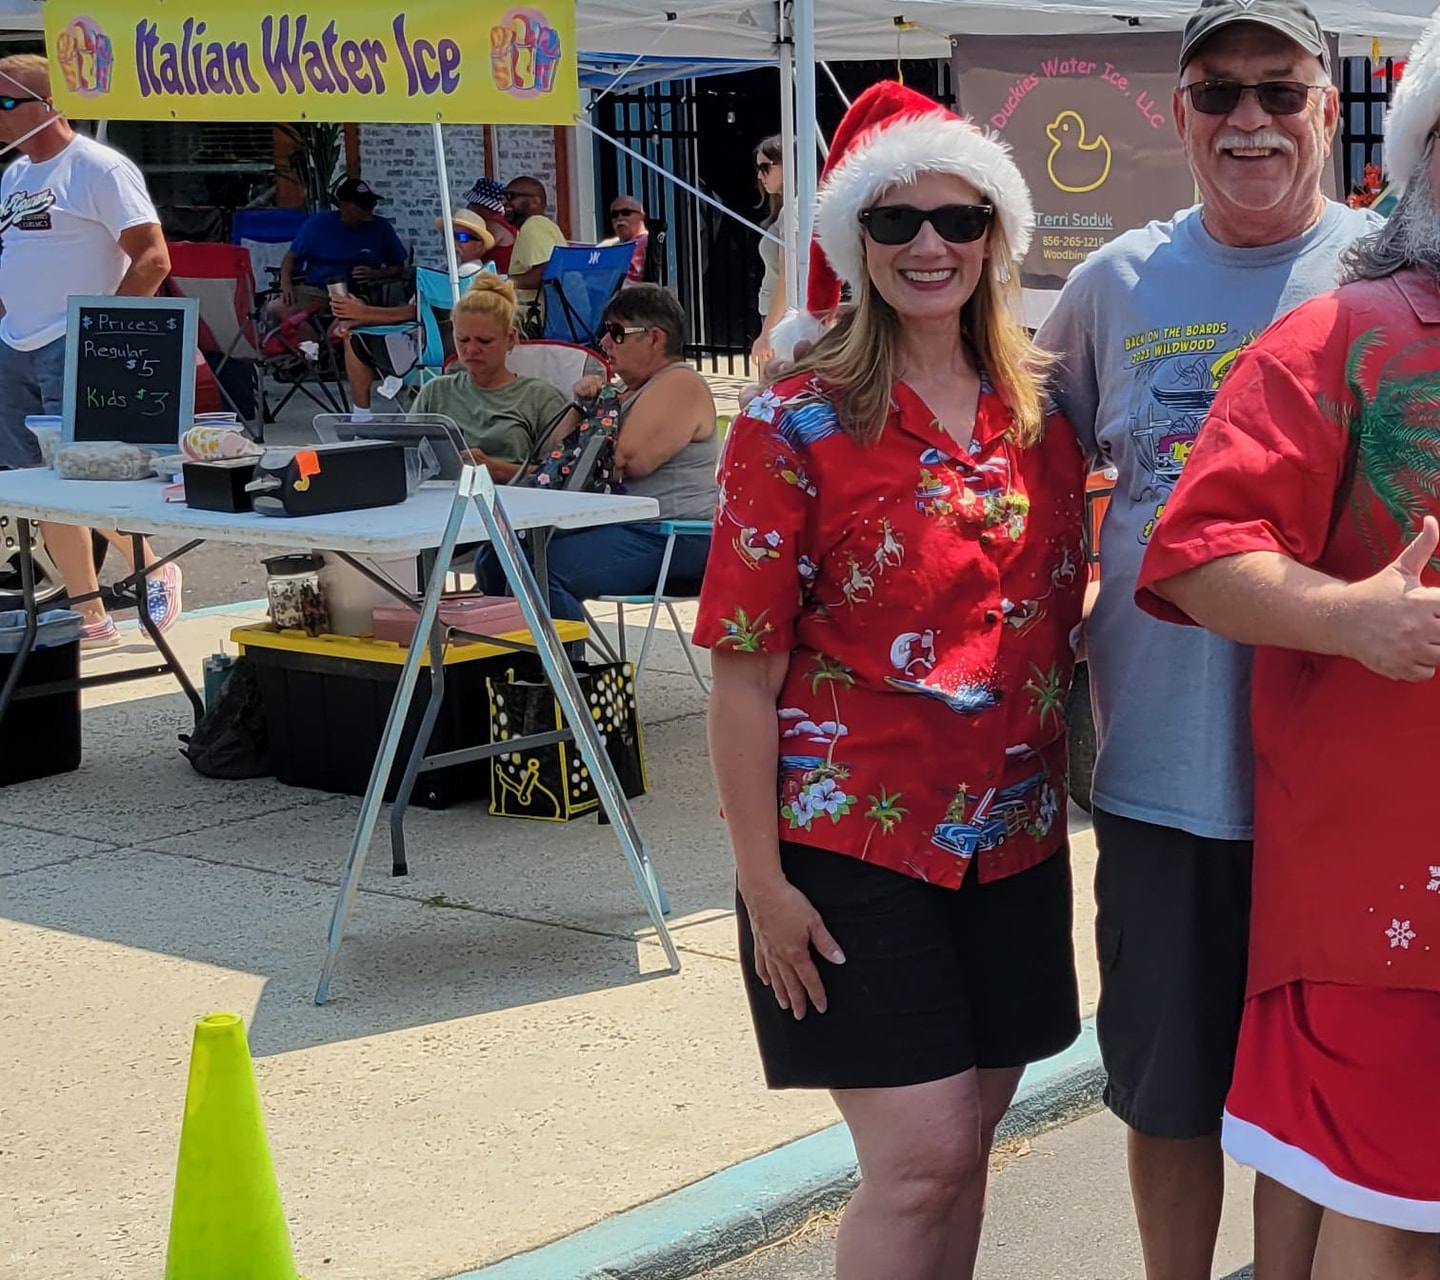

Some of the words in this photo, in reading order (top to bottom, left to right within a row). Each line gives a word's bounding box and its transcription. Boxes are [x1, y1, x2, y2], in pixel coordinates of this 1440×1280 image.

[135, 17, 260, 98] Italian
[261, 13, 387, 95] Water
[393, 12, 461, 97] Ice
[990, 71, 1040, 129] Duckies
[1041, 56, 1097, 79] Water
[1101, 62, 1130, 98] Ice,
[1135, 90, 1166, 129] LLC
[1034, 212, 1068, 226] Terri
[1072, 212, 1113, 227] Saduk
[99, 313, 159, 331] Prices
[1124, 333, 1145, 351] BACK
[1147, 330, 1159, 342] ON
[1163, 327, 1182, 339] THE
[1186, 322, 1228, 336] BOARDS
[84, 340, 149, 359] Regular
[1154, 338, 1216, 357] WILDWOOD
[87, 386, 127, 408] Kids
